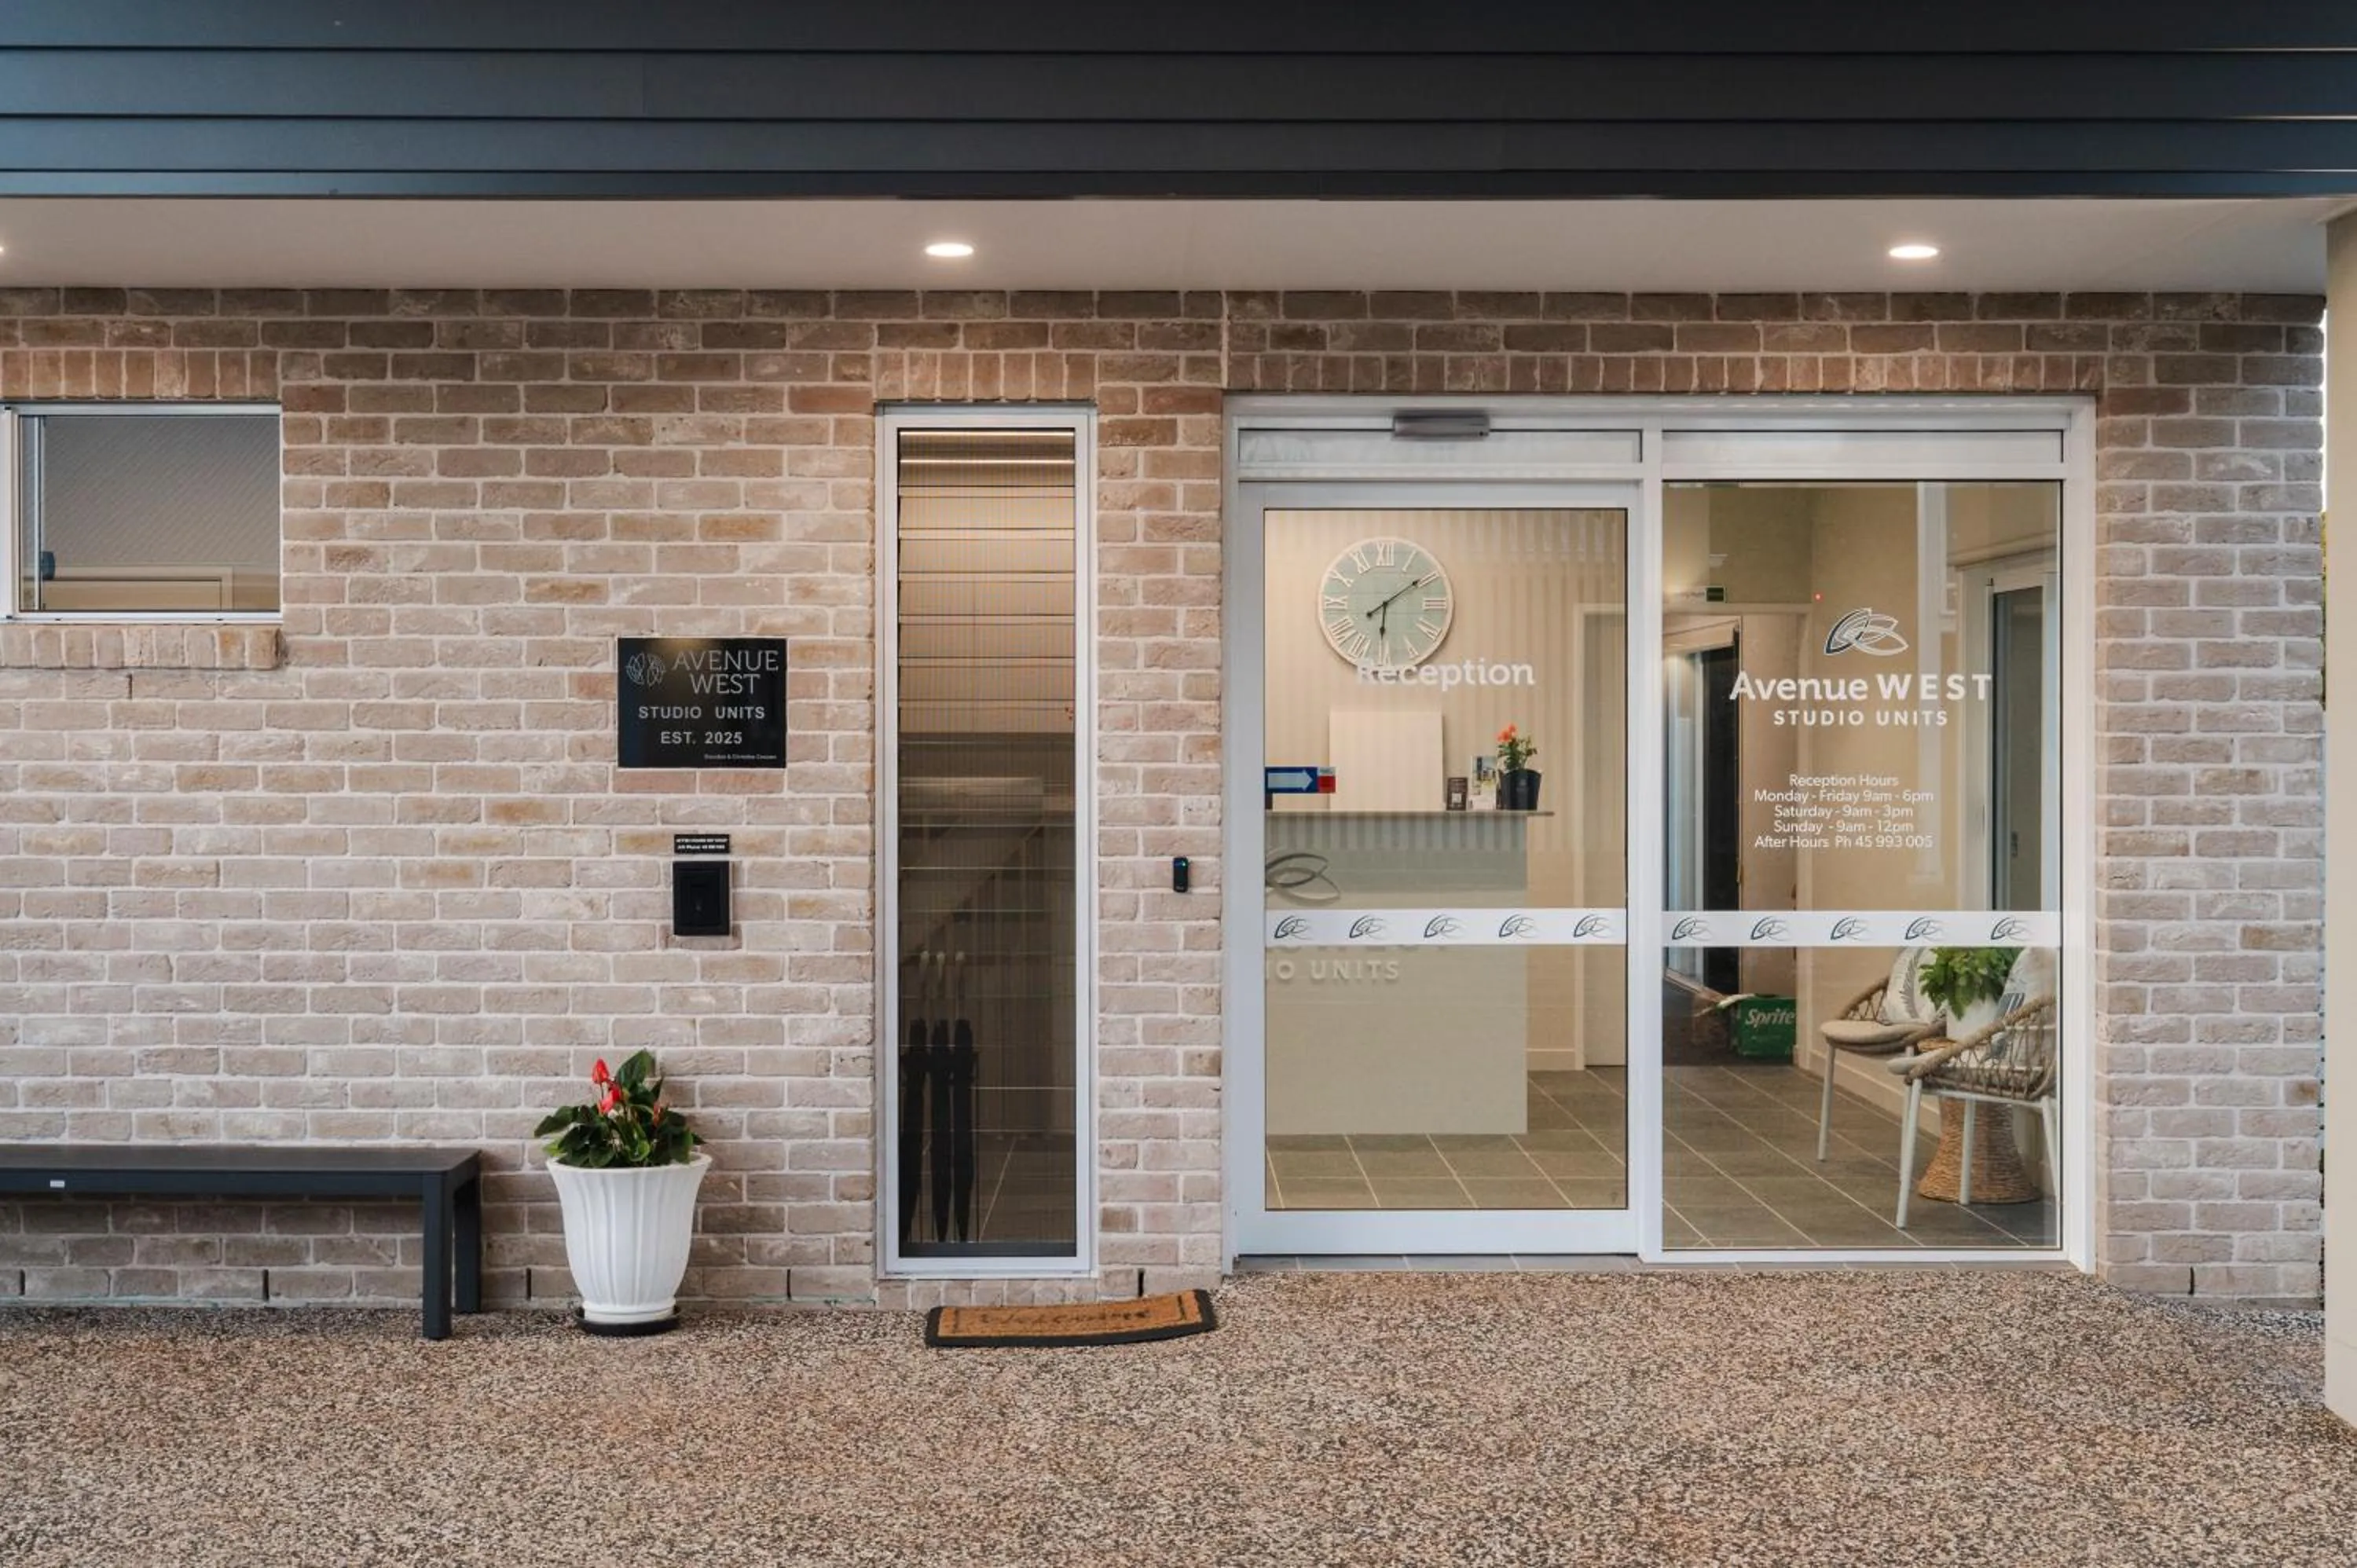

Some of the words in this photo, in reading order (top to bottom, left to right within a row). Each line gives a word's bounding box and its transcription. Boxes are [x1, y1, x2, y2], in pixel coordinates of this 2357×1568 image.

[673, 650, 779, 672] AVENUE
[689, 673, 761, 694] WEST
[1357, 658, 1536, 692] Reception
[1729, 670, 1869, 702] Avenue
[1875, 673, 1992, 701] WEST
[638, 706, 702, 720] STUDIO
[714, 706, 766, 720] UNITS
[1772, 709, 1865, 727] STUDIO
[1875, 710, 1949, 727] UNITS
[660, 731, 698, 745] EST.
[704, 731, 743, 745] 2025
[1789, 774, 1856, 789] Reception
[1859, 774, 1900, 787] Hours
[1754, 789, 1809, 804] Monday
[1819, 788, 1860, 804] Friday
[1862, 789, 1893, 802] 9am
[1774, 804, 1833, 819] Saturday
[1842, 804, 1873, 817] 9am
[1882, 804, 1914, 820] 3pm
[1773, 819, 1824, 835] Sunday
[1835, 819, 1867, 833] 9am
[1876, 819, 1915, 835] 12pm
[1754, 835, 1787, 848] After
[1789, 835, 1830, 848] Hours
[1835, 835, 1853, 848] Ph
[1855, 835, 1873, 848] 45
[1875, 835, 1902, 848] 993
[1309, 958, 1399, 980] UNITS
[1744, 1008, 1795, 1028] Sprite
